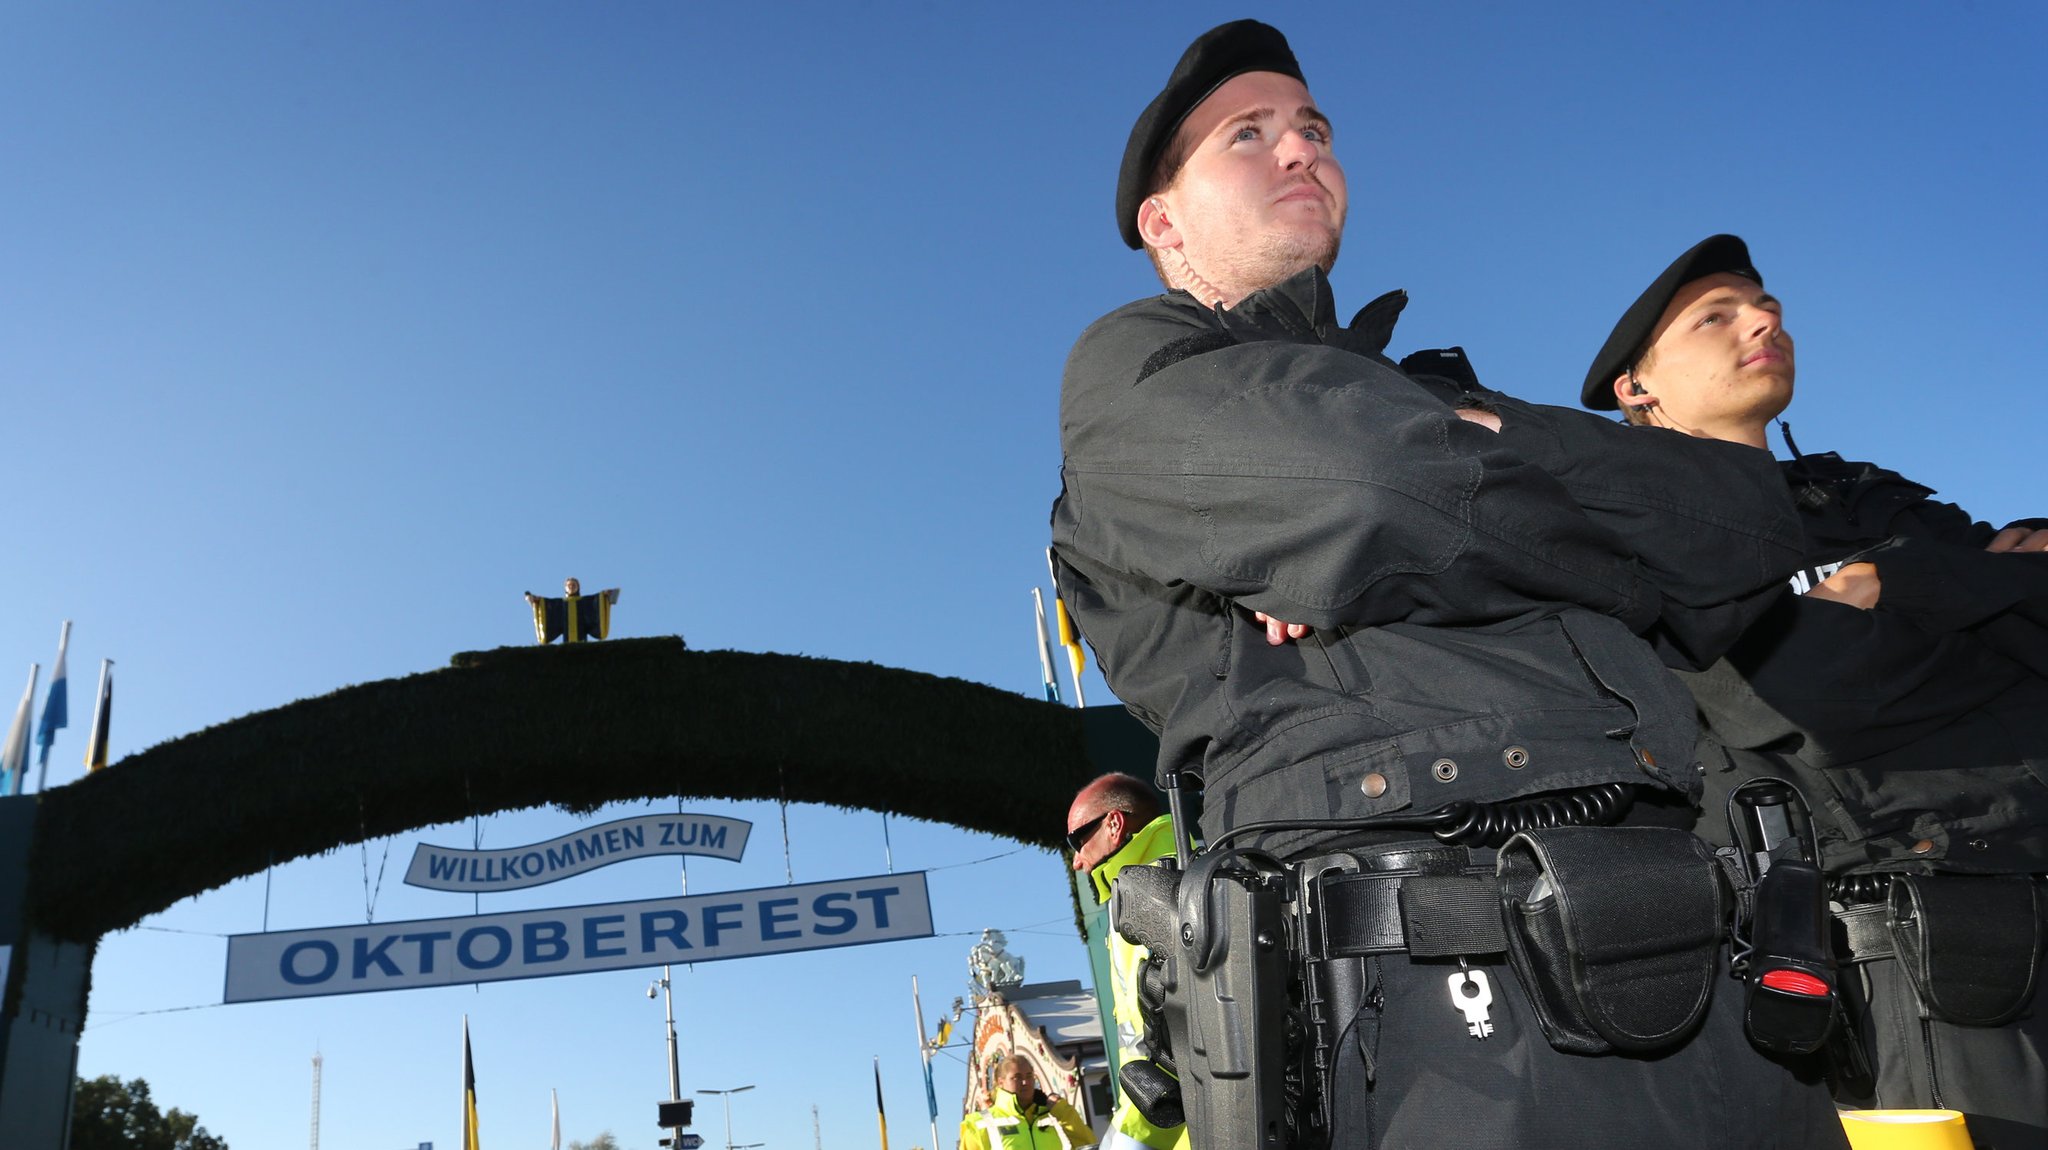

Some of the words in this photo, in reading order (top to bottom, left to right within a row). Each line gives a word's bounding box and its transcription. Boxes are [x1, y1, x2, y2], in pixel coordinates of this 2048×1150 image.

[428, 824, 644, 883] WILLKOMMEN
[659, 822, 728, 849] ZUM
[280, 888, 900, 984] OKTOBERFEST
